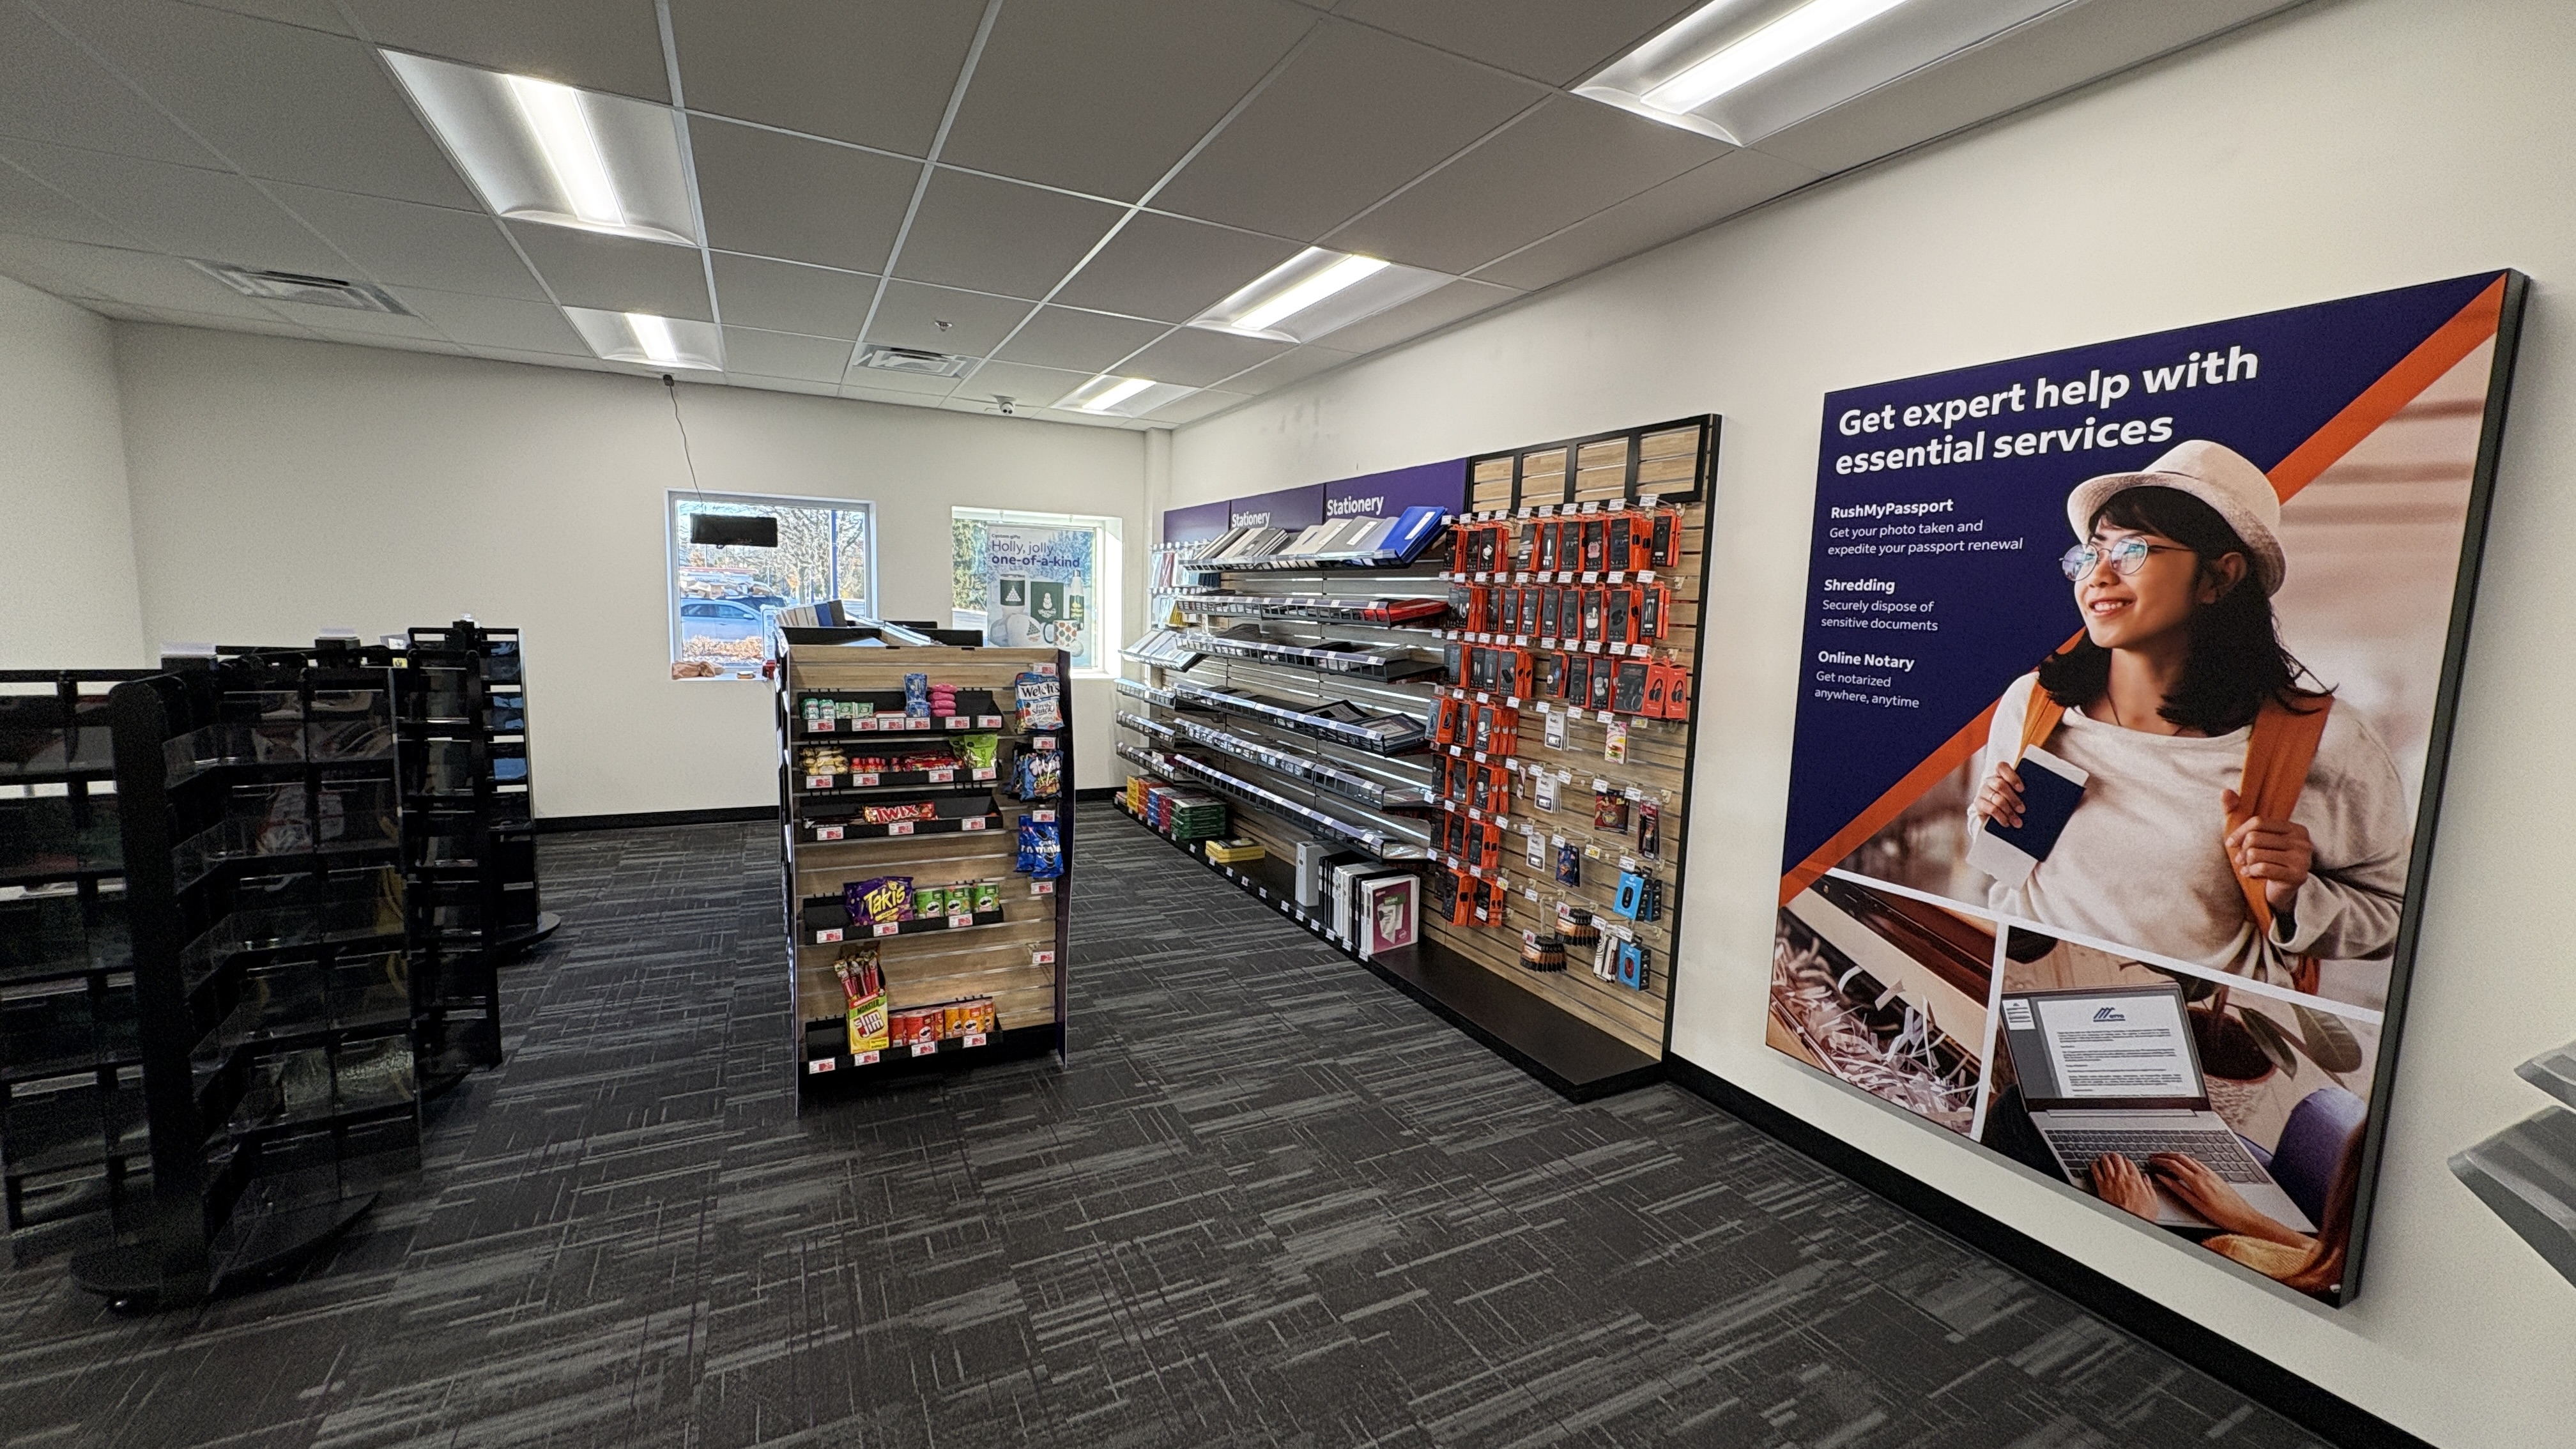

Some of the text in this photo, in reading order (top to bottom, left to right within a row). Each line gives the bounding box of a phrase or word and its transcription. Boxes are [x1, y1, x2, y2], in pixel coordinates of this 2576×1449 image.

[1839, 346, 2258, 435] Get expert help with
[1836, 417, 2173, 474] essential services
[1327, 496, 1384, 516] Stationery
[1831, 499, 1954, 519] RushMyPassport
[1232, 511, 1270, 529] Stationery
[1830, 520, 1983, 539] Get your photo taken and
[992, 540, 1054, 556] Holly, jolly
[1828, 538, 2023, 557] expedite your passport renewal
[992, 555, 1080, 567] one-of-a-kind
[1824, 579, 1896, 595] Shredding
[1823, 600, 1935, 613] Securely dispose of
[1821, 617, 1938, 631] sensitive documents
[1818, 651, 1915, 672] Online Notary
[1816, 671, 1891, 687] Get notarized
[1814, 689, 1920, 709] anywhere, anytime
[863, 882, 905, 919] Takis
